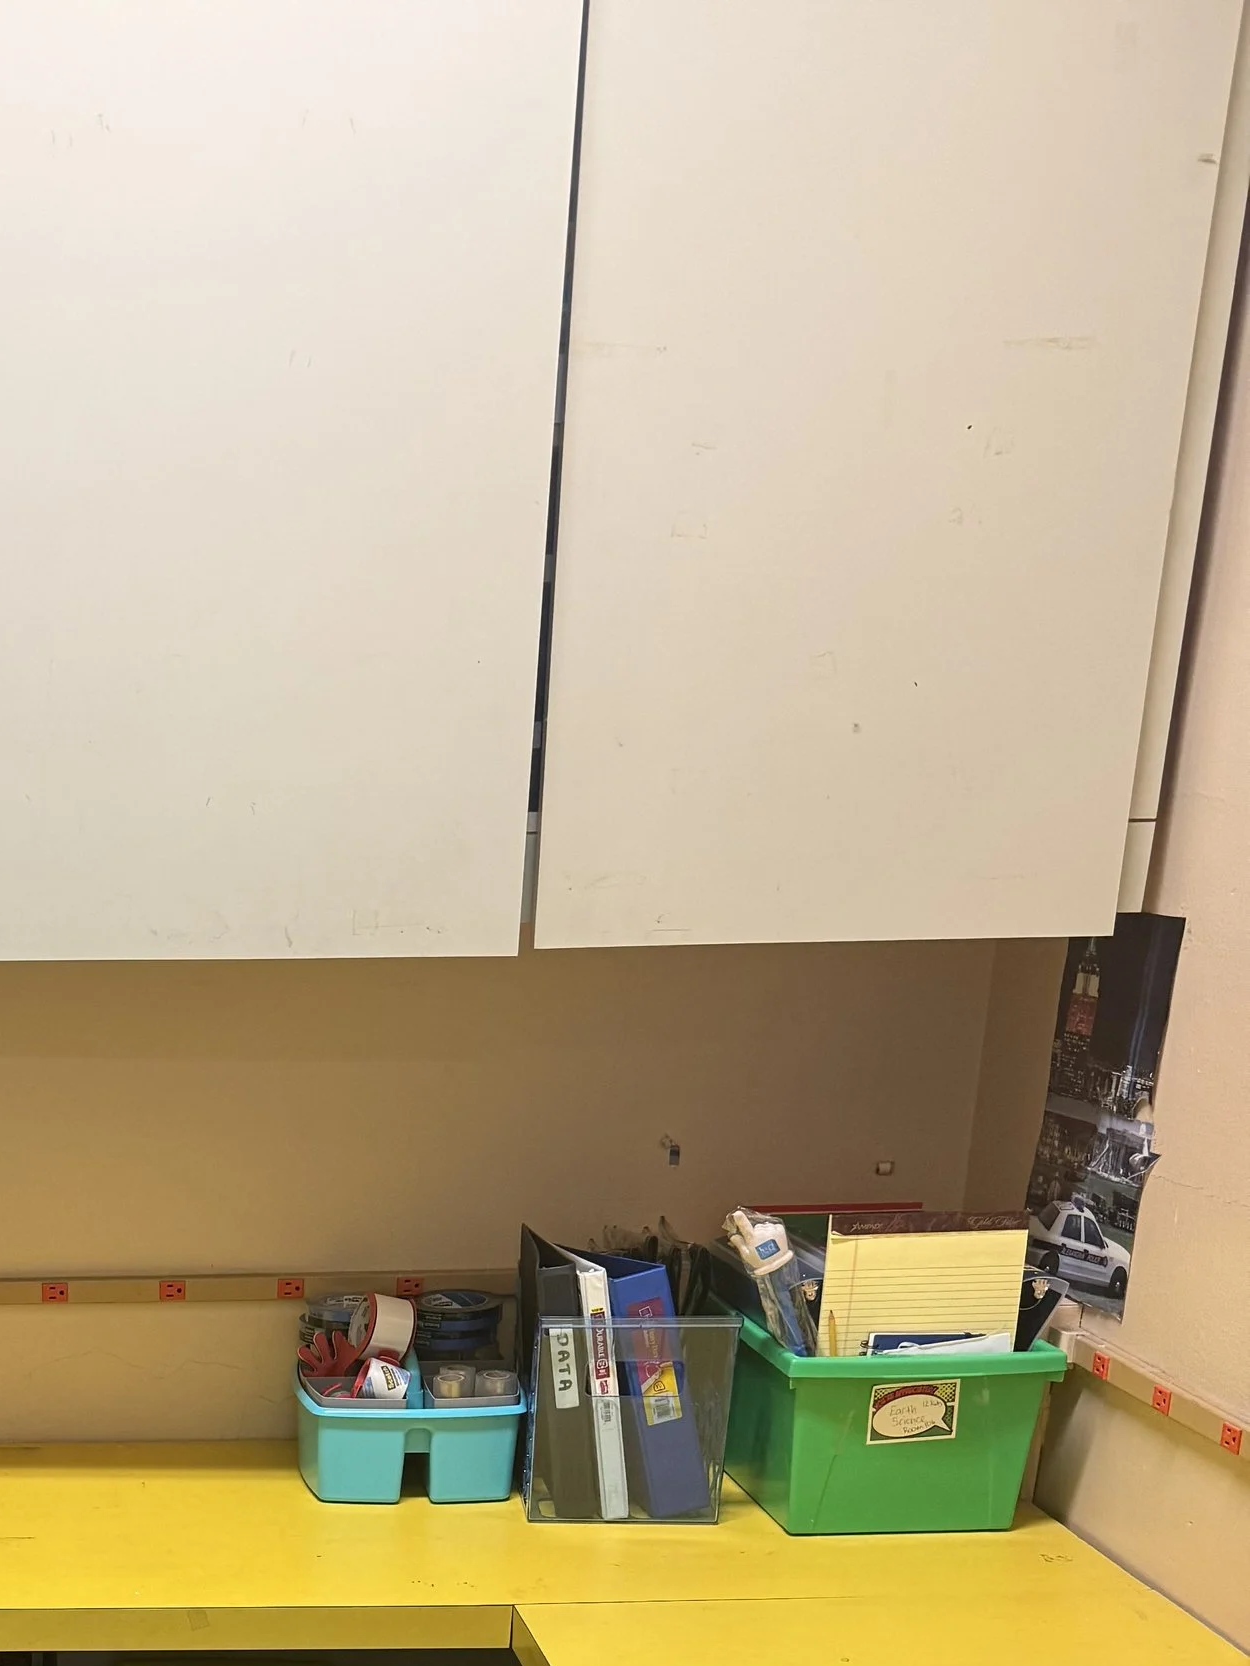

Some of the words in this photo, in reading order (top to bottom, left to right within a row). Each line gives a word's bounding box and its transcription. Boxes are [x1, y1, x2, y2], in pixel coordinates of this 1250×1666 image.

[557, 1333, 573, 1392] DATA
[890, 1404, 917, 1416] Earth
[892, 1416, 925, 1427] Science
